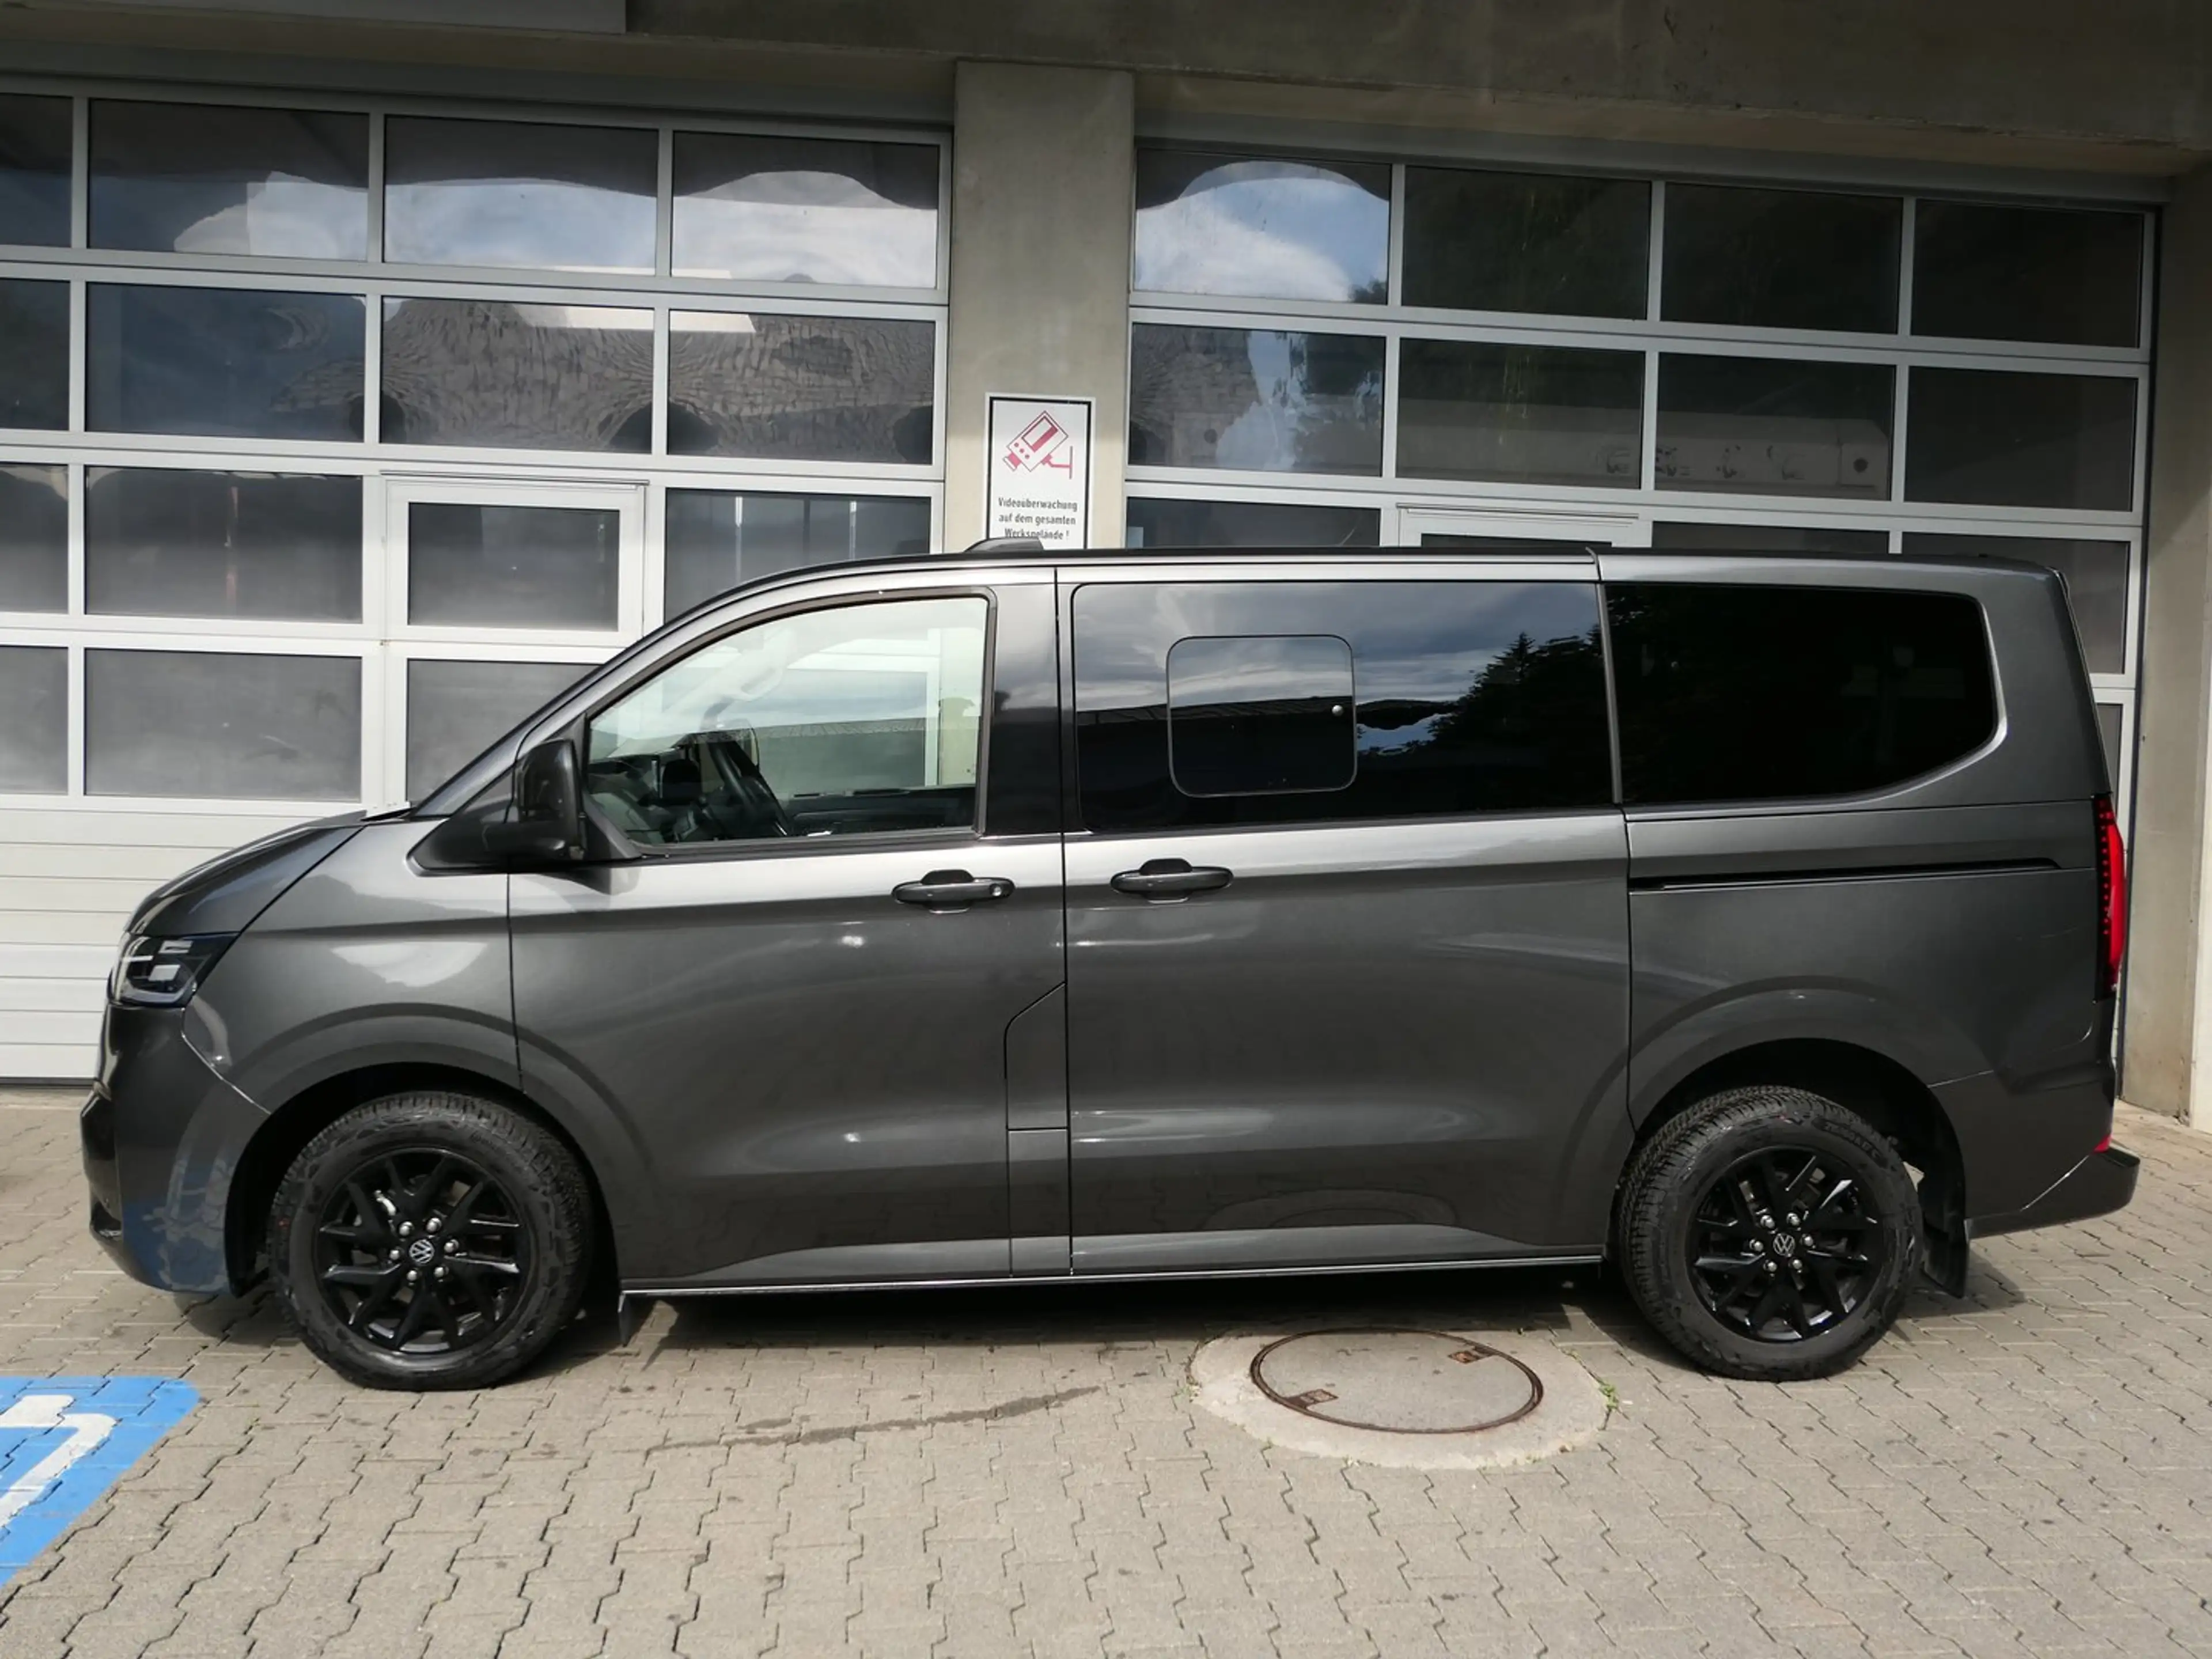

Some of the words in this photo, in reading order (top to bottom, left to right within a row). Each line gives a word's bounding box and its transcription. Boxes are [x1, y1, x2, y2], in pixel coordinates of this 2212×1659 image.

[999, 513, 1013, 522] auf
[1015, 513, 1033, 523] dem
[1035, 515, 1076, 526] gesamten
